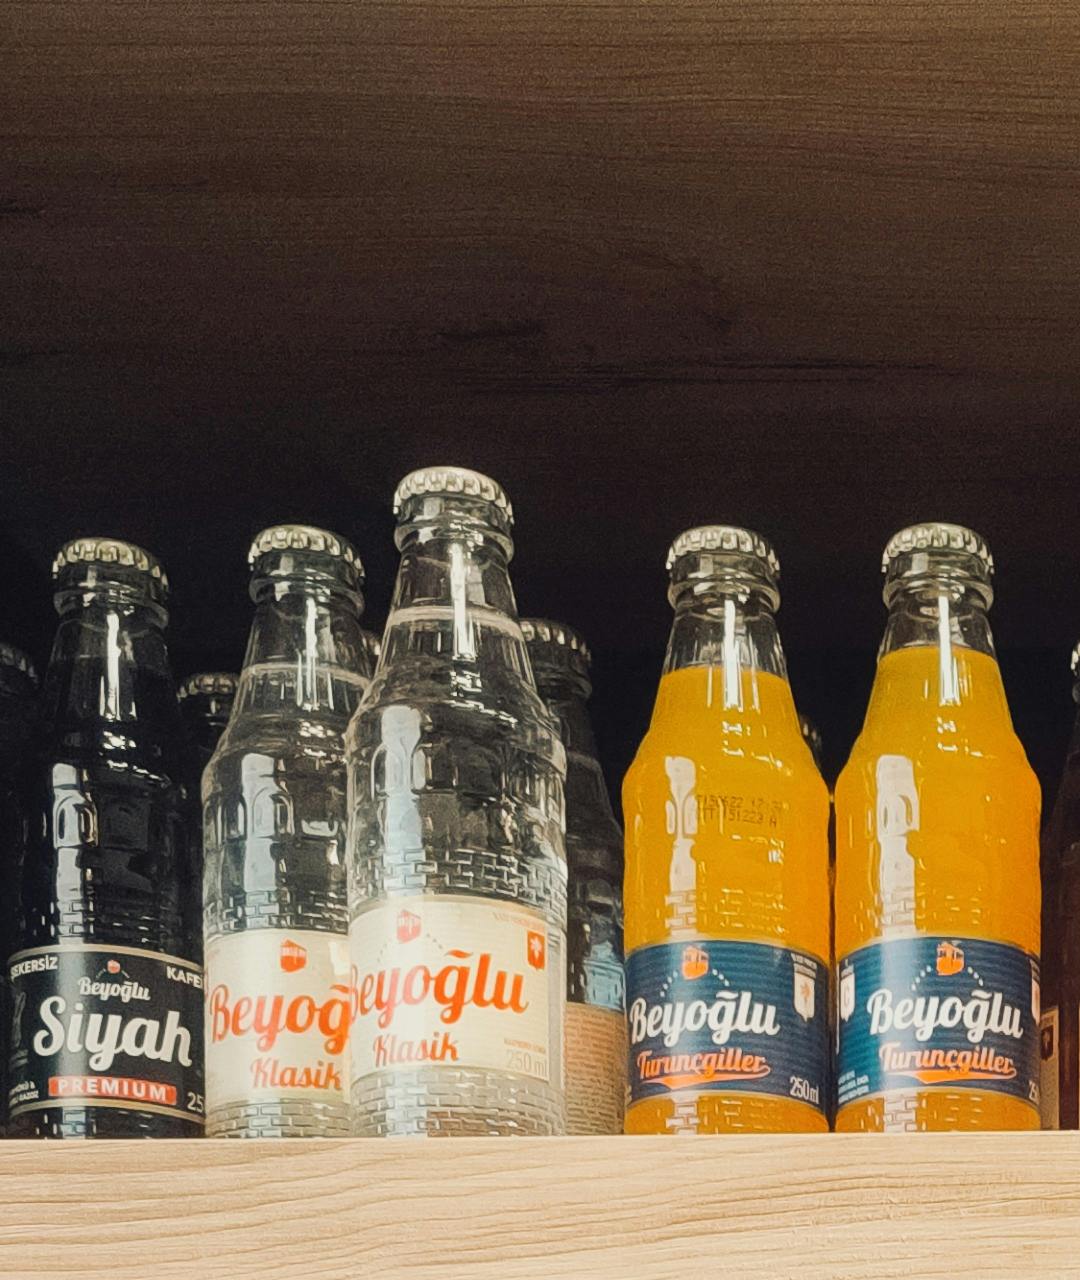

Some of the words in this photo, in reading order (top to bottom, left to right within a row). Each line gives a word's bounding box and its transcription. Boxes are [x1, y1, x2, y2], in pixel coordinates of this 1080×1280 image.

[79, 976, 151, 1003] Beyoğlu
[166, 965, 204, 989] KAFE
[630, 990, 781, 1047] Beyoğlu
[866, 988, 1024, 1043] Beyoğlu
[33, 995, 193, 1072] Siyah
[373, 1031, 460, 1068] Klasik
[251, 1057, 343, 1092] Klasik
[637, 1047, 767, 1079] Turunçgiller
[879, 1042, 1015, 1074] Turunçgiller
[58, 1078, 167, 1101] PREMIUM
